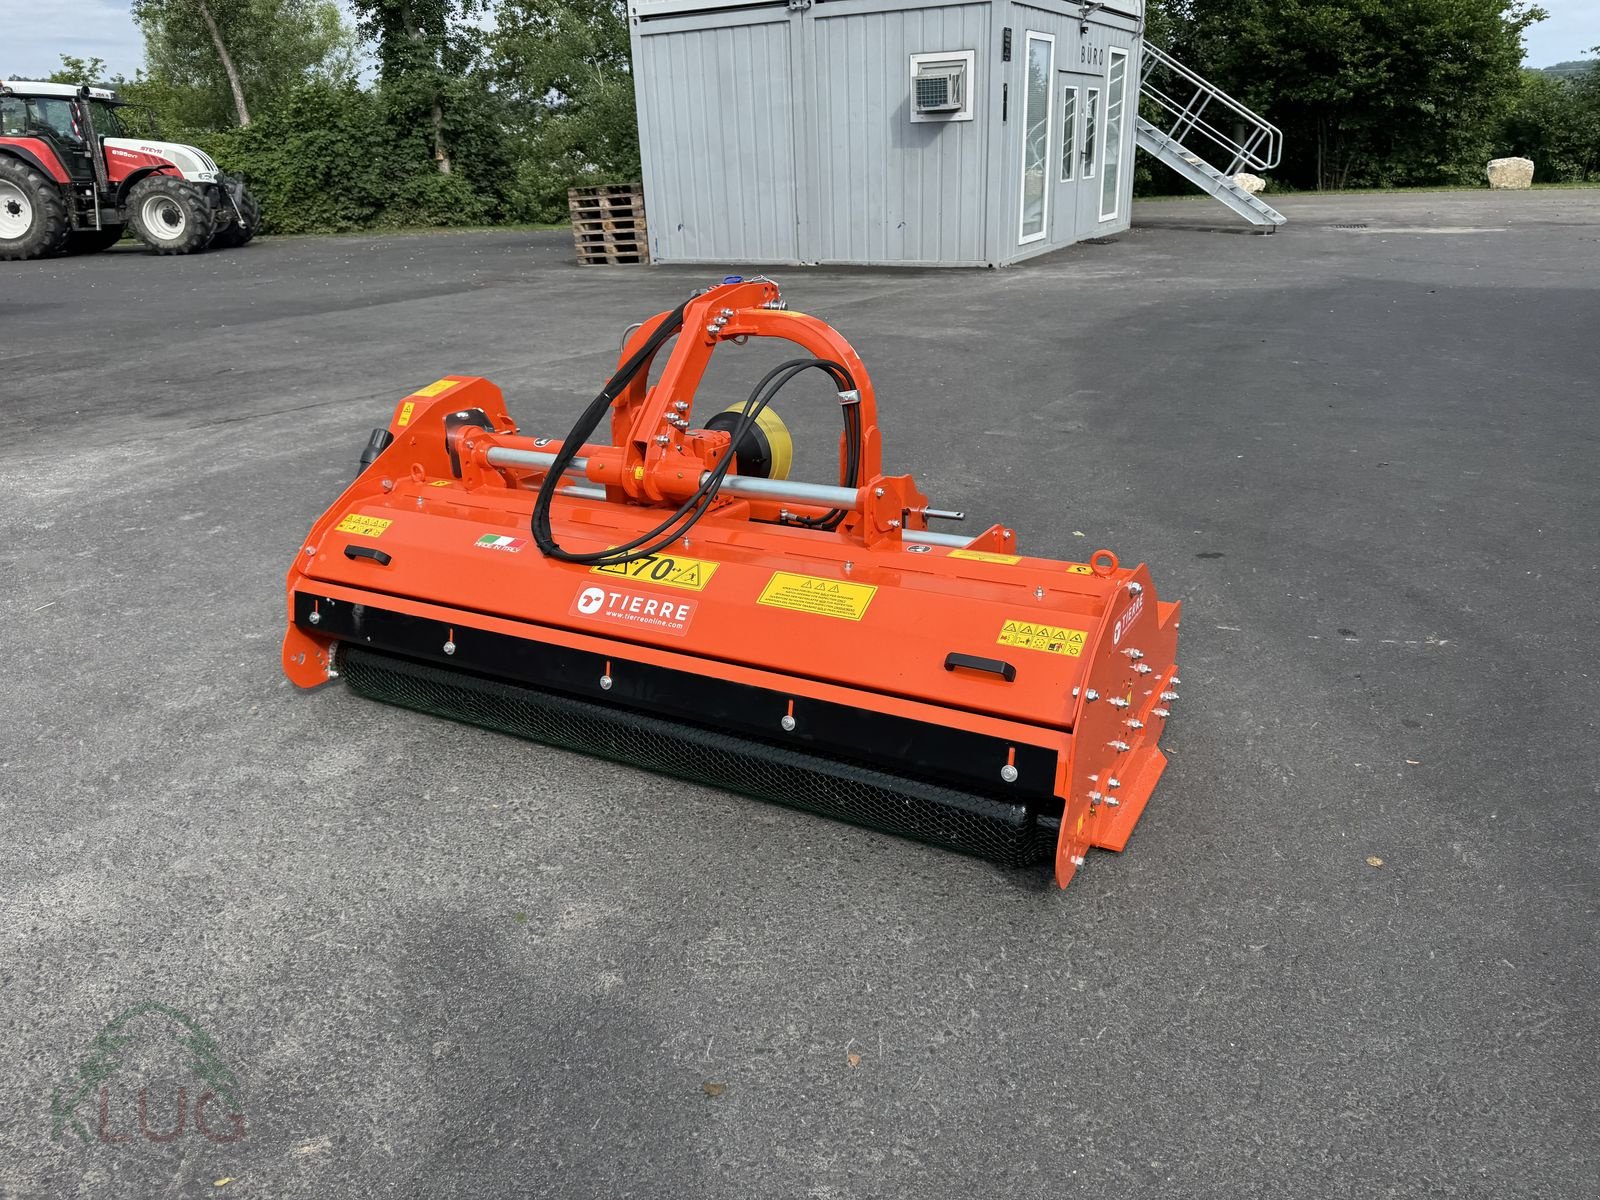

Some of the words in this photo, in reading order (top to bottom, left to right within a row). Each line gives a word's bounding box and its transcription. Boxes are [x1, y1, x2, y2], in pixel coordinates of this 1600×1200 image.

[1081, 42, 1104, 66] BÜRO
[140, 146, 163, 154] STEYR
[632, 556, 675, 580] 70
[608, 592, 690, 621] TIERRE
[1122, 592, 1144, 628] TIERRE
[605, 610, 684, 629] www.tierreonline.com
